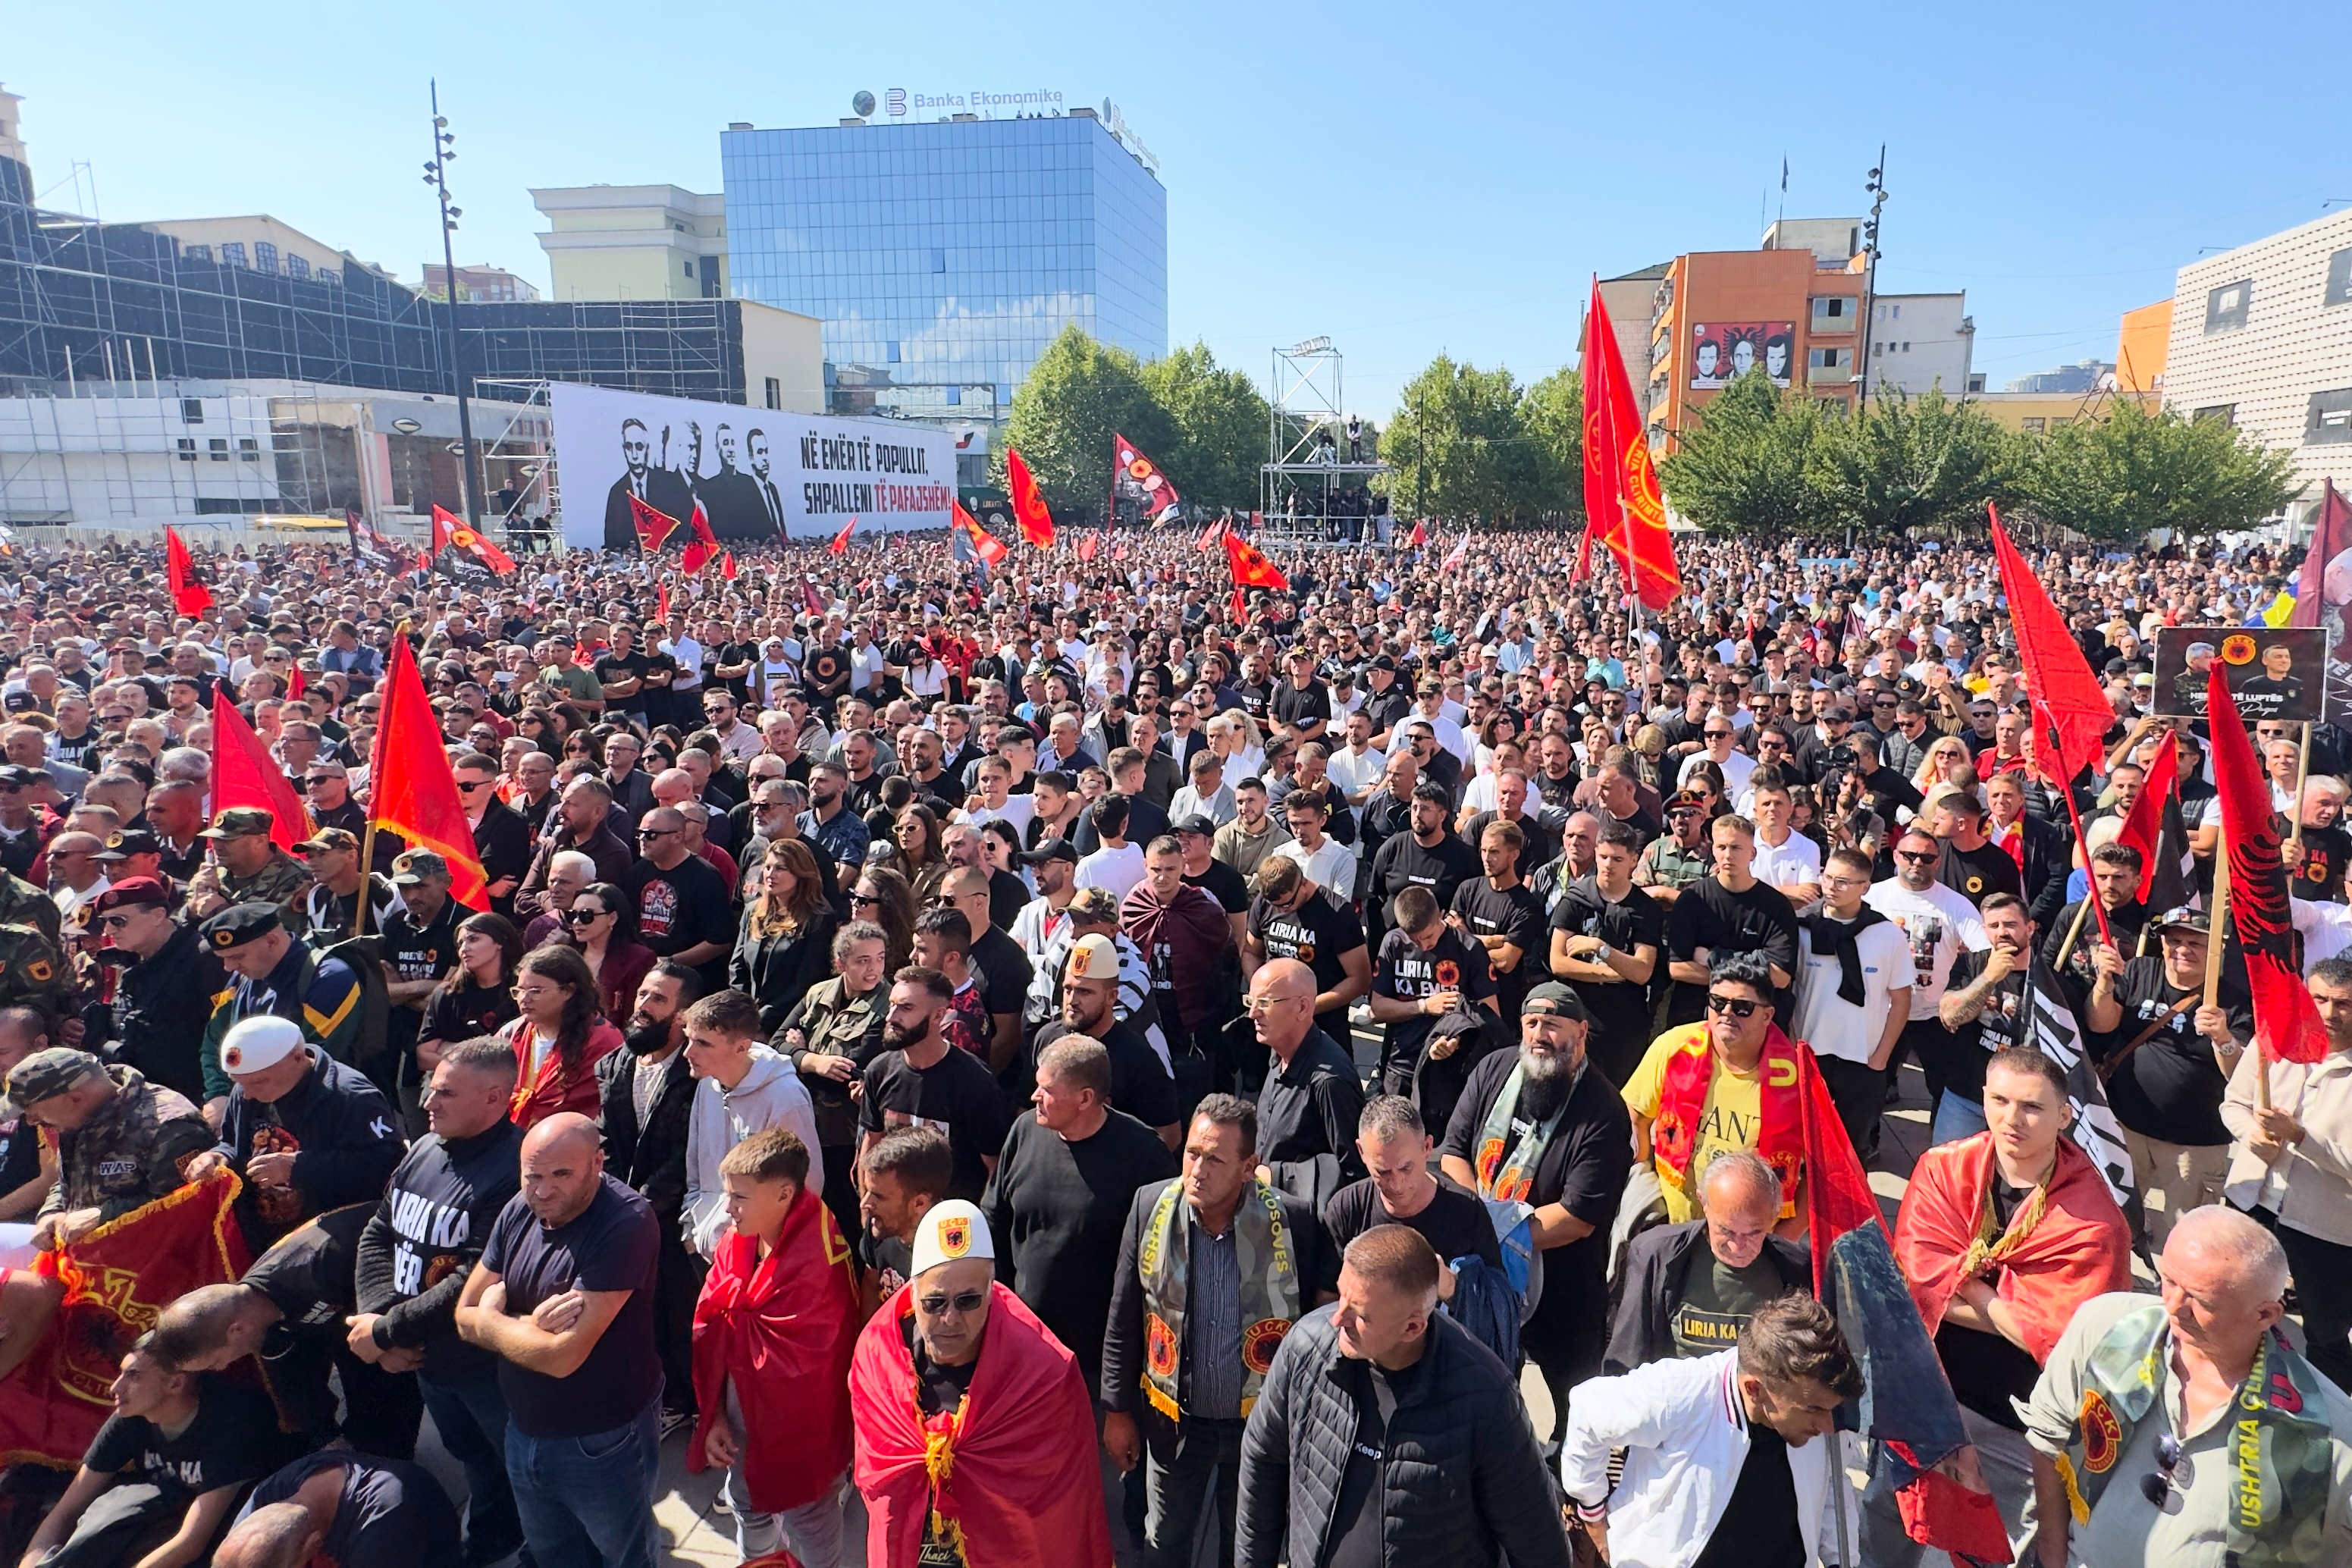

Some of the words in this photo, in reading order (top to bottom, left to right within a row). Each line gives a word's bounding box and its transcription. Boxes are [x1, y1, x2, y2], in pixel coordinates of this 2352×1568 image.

[914, 94, 965, 108] Banka
[971, 89, 1062, 105] Ekonomike
[801, 430, 819, 469] NË
[821, 433, 857, 472] EMËR
[858, 436, 871, 472] TË
[876, 443, 928, 476] POPULLIT,
[804, 482, 873, 514] SHPALLENI
[873, 478, 888, 513] TË
[889, 480, 952, 513] PAFAJSHËM!
[2231, 691, 2244, 701] TË
[1269, 921, 1297, 942] LIRIA
[1298, 927, 1316, 946] KA
[1394, 959, 1432, 979] LIRIA
[1394, 978, 1415, 996] KA
[392, 1187, 434, 1243] LIRIA
[430, 1205, 469, 1248] KA
[1142, 1197, 1174, 1275] USHTRIA
[1684, 1318, 1717, 1339] LIRIA
[1719, 1323, 1738, 1341] KA
[2239, 1419, 2262, 1528] USHTRIA
